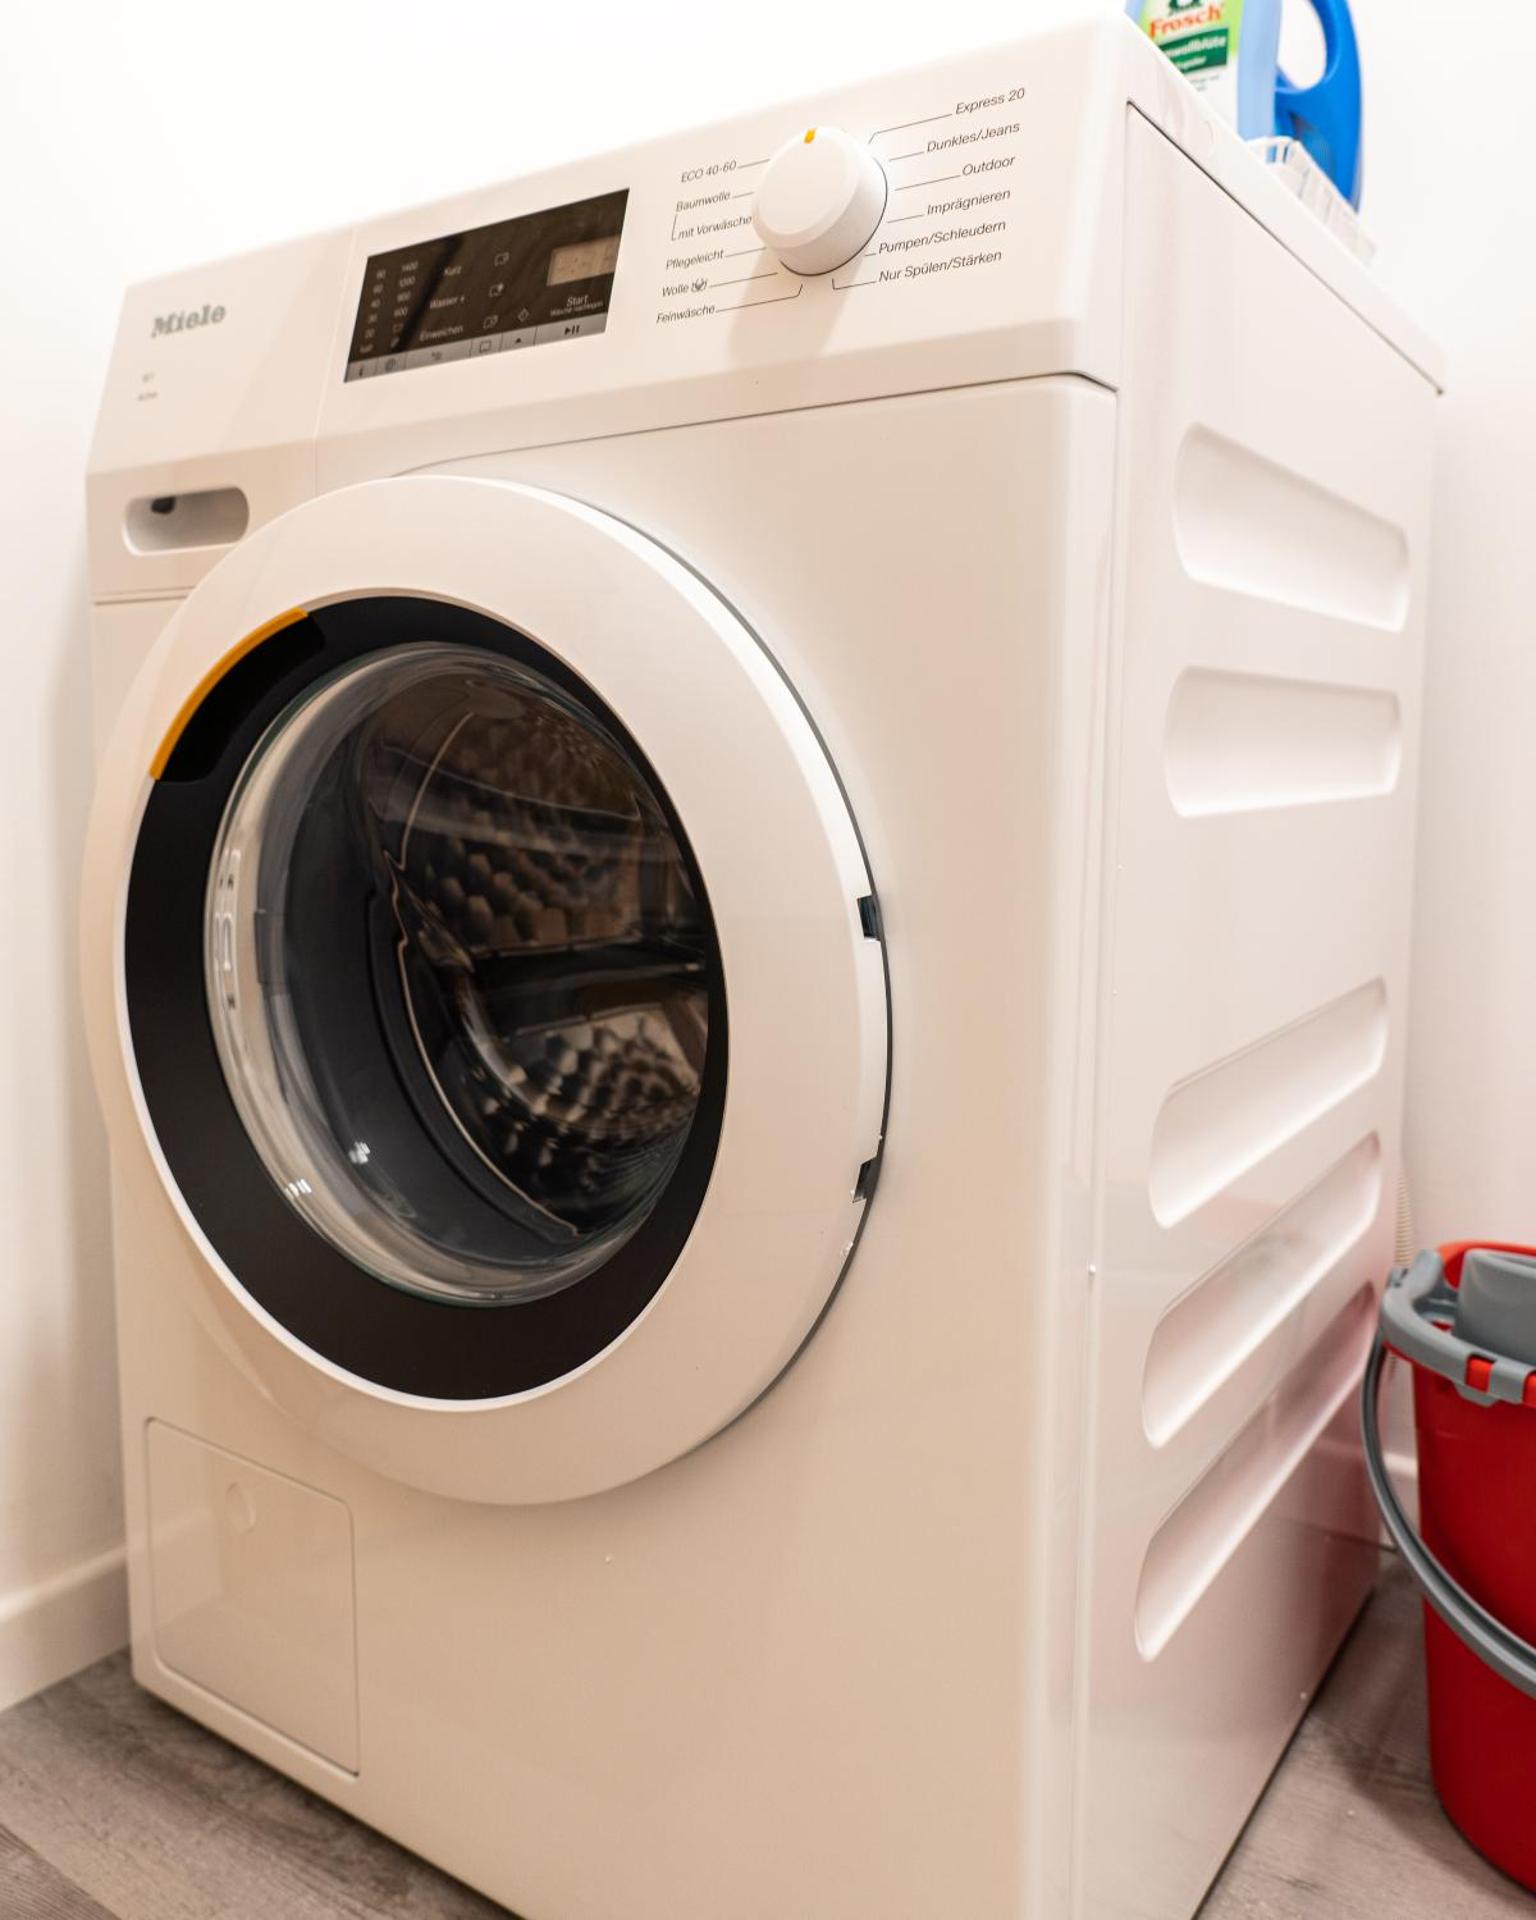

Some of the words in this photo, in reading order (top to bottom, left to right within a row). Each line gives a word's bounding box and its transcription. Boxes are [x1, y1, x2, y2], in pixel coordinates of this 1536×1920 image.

[1149, 4, 1222, 39] Frosch
[955, 95, 1005, 115] Express
[1008, 87, 1025, 102] 20
[926, 122, 1020, 153] Dunkles/Jeans
[681, 168, 704, 183] ECO
[706, 160, 737, 176] 40-60
[962, 156, 1016, 177] Outdoor
[676, 191, 731, 212] Baumwolle
[927, 189, 1011, 216] Imprägnieren
[678, 226, 694, 240] mit
[696, 215, 752, 236] Vorwäsche
[878, 220, 1006, 254] Pumpen/Schleudern
[665, 249, 724, 271] Pflegeleicht
[878, 267, 902, 283] Nur
[904, 250, 1002, 279] Spülen/Stärken
[566, 294, 589, 308] Start
[662, 283, 689, 297] Wolle
[151, 303, 226, 339] Miele
[656, 304, 716, 324] Feinwäsche
